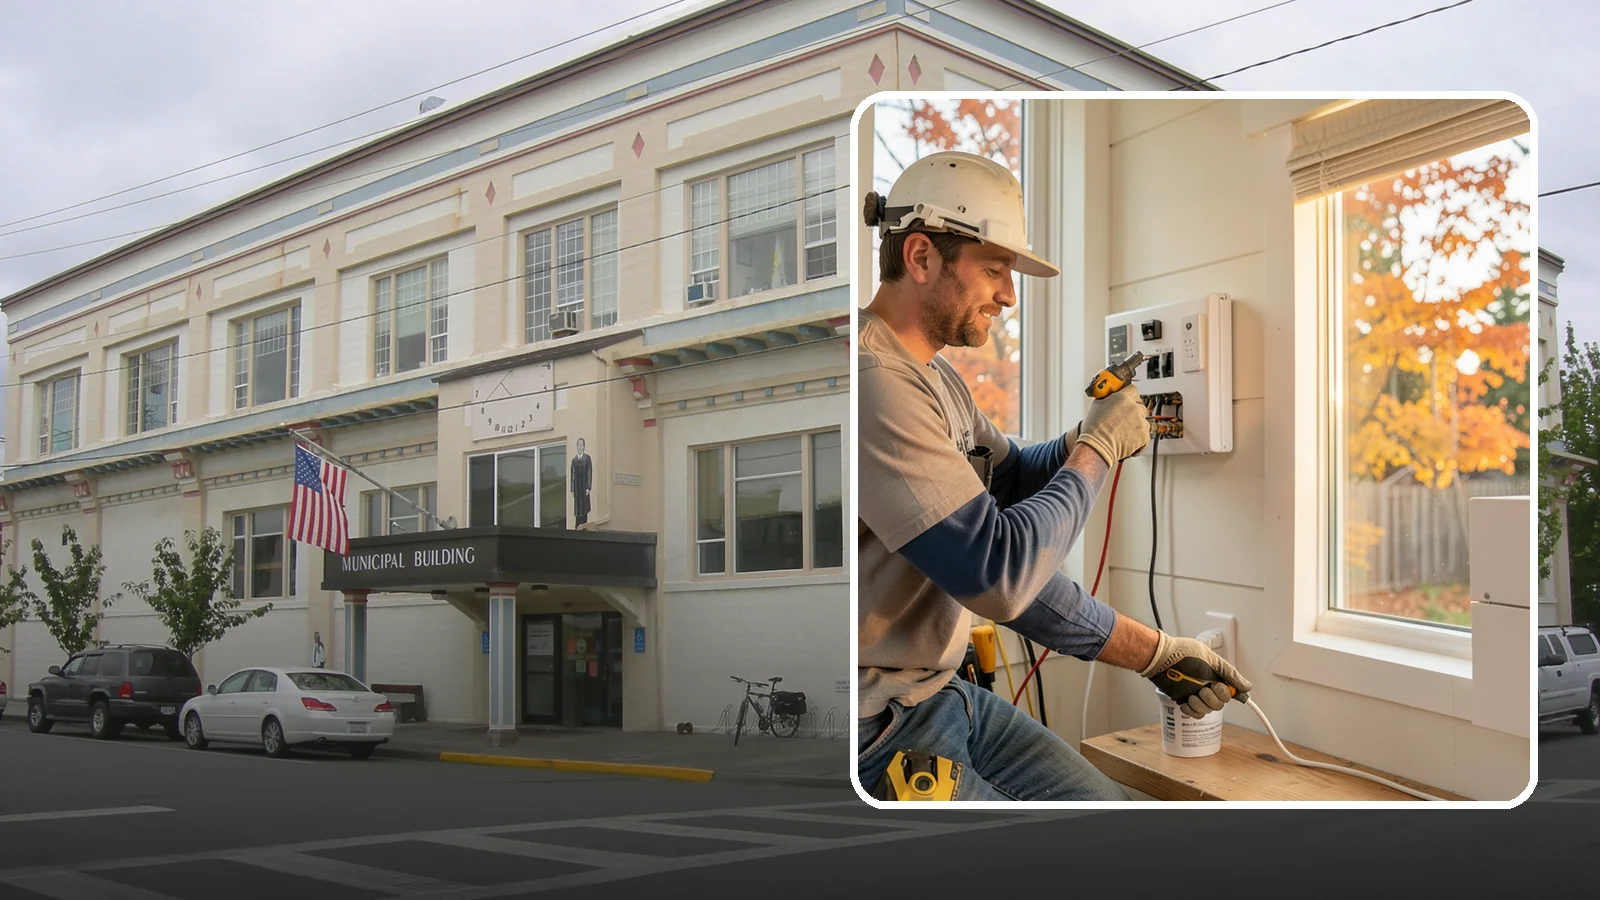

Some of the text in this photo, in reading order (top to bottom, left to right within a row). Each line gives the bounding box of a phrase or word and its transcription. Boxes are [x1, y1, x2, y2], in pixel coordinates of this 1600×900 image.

[487, 417, 492, 426] 9
[494, 423, 500, 432] 10
[501, 425, 506, 433] 11
[507, 425, 514, 433] 12
[521, 420, 526, 428] 2
[529, 413, 533, 422] 3
[536, 402, 540, 410] 4
[341, 546, 476, 572] MUNICIPAL BUILDING
